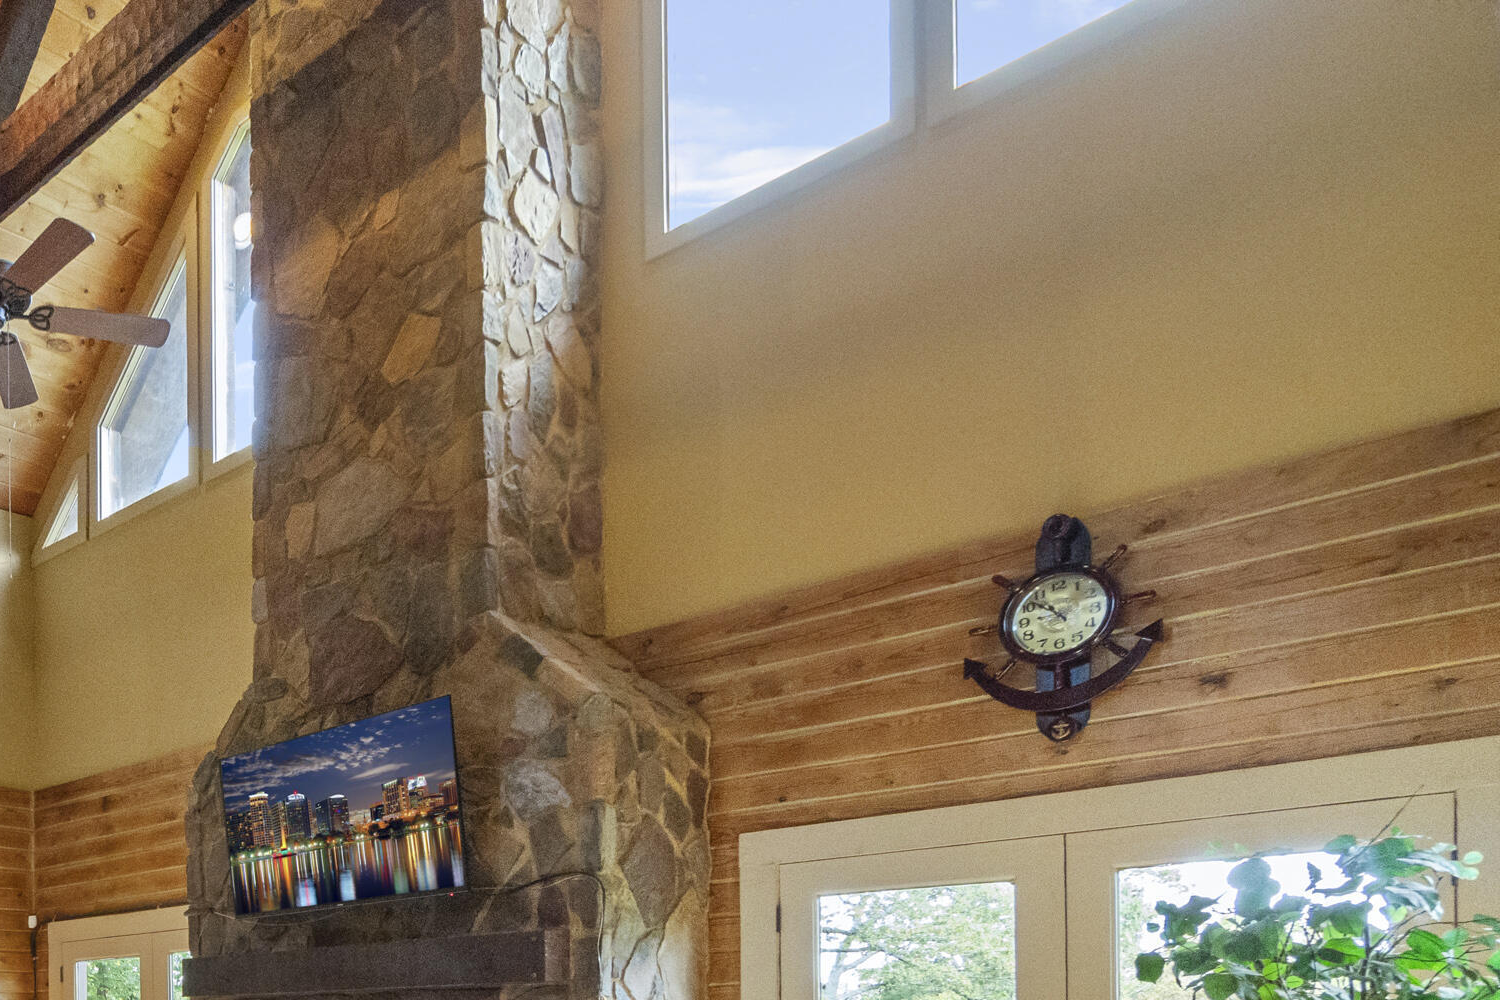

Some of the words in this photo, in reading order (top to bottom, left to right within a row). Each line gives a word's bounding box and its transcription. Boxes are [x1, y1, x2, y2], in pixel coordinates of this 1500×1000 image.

[1051, 580, 1067, 591] 12
[1034, 590, 1046, 600] 11
[1084, 587, 1097, 599] 2
[1022, 602, 1035, 613] 10
[1089, 601, 1102, 613] 3
[1018, 617, 1030, 628] 9
[1084, 617, 1096, 627] 4
[1022, 630, 1034, 641] 8
[1071, 631, 1084, 643] 5
[1036, 638, 1049, 648] 7
[1054, 638, 1065, 649] 6
